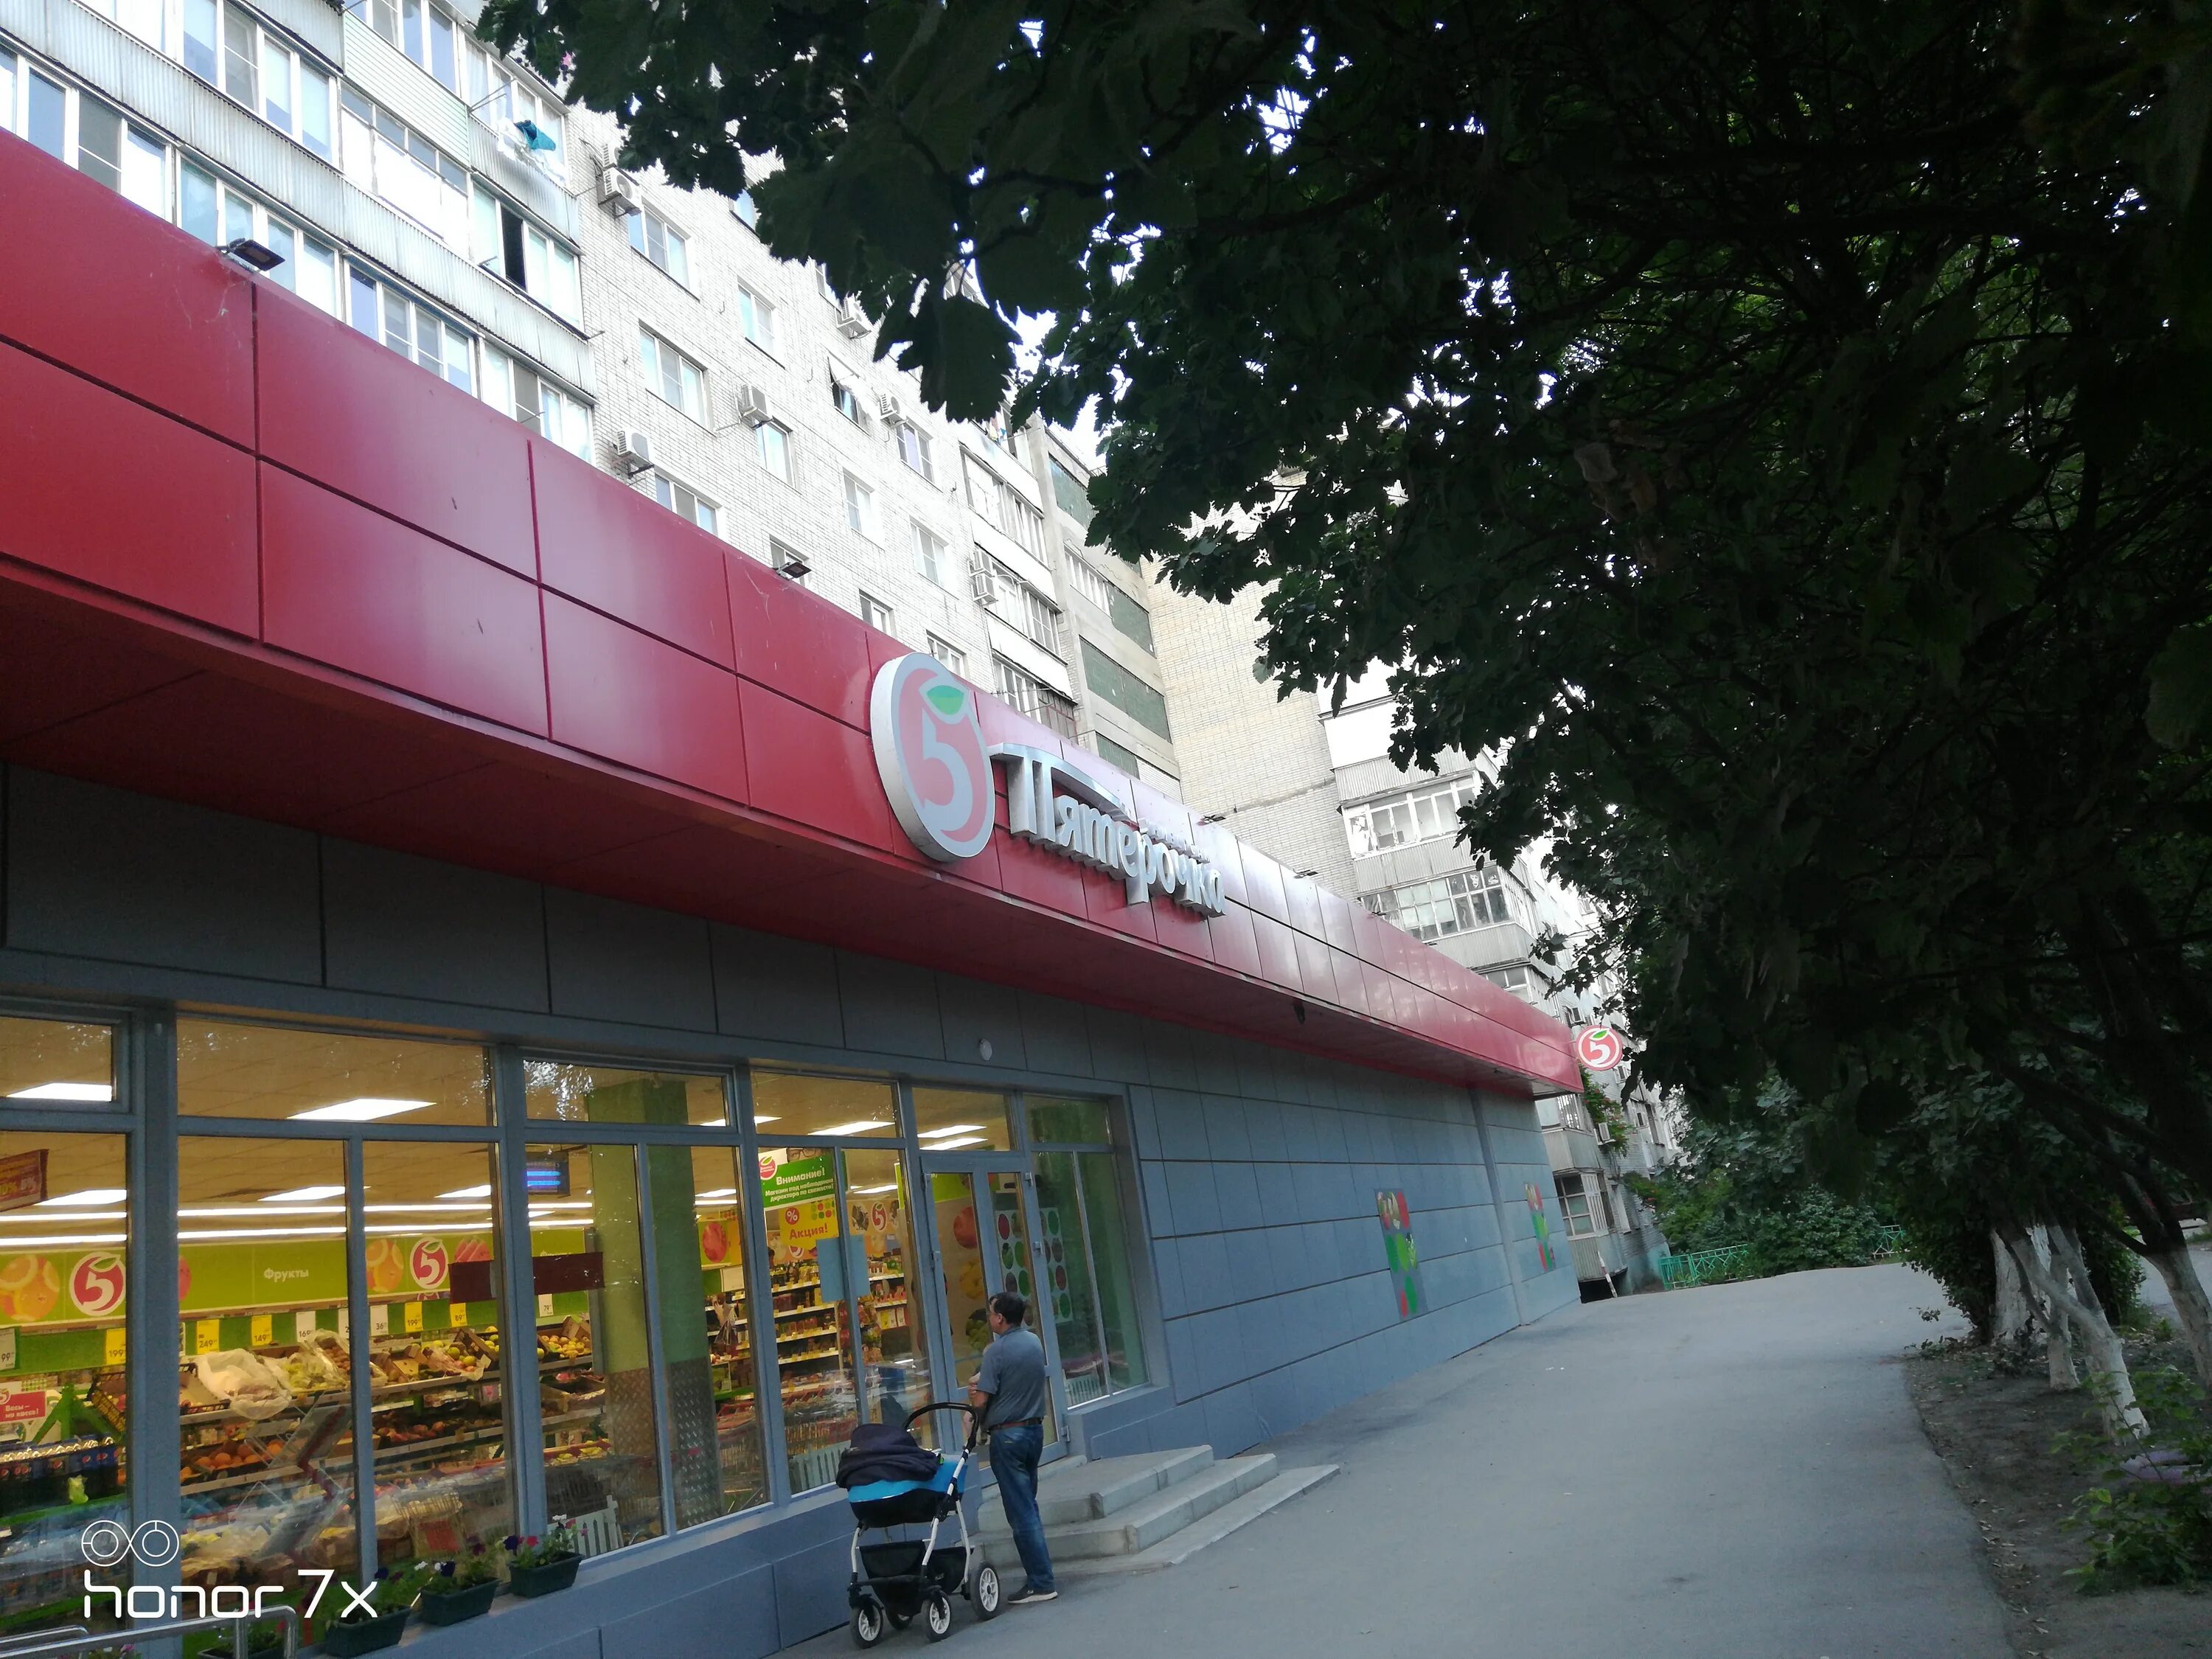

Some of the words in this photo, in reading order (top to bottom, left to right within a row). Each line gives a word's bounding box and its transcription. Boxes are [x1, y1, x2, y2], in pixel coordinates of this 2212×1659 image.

[776, 1167, 825, 1186] Внимание!
[790, 1222, 828, 1239] Акция!
[264, 1267, 309, 1283] Фрукты
